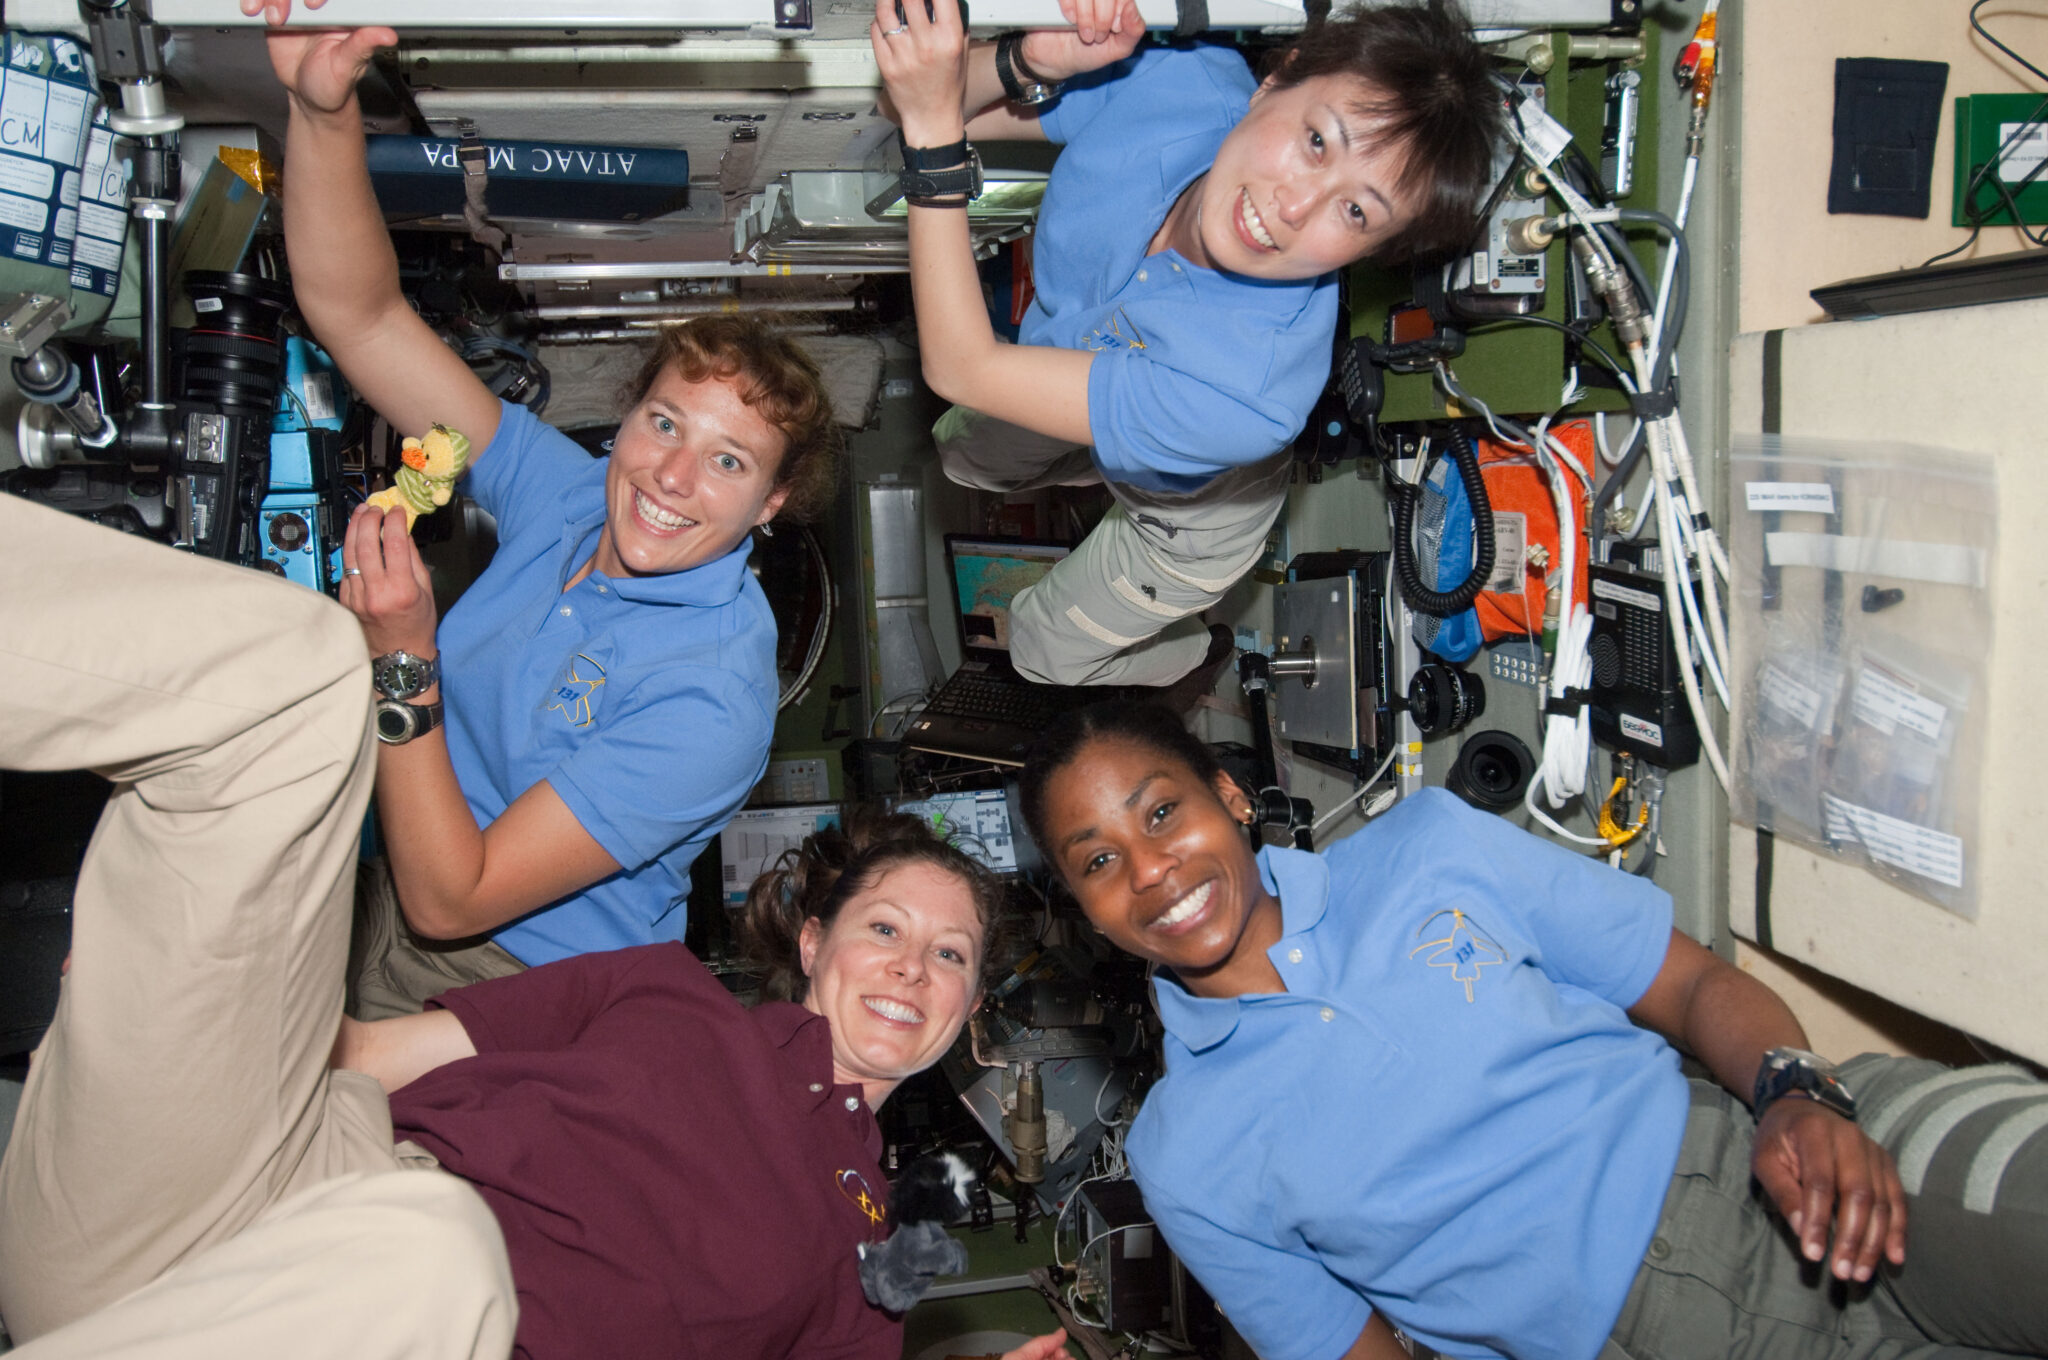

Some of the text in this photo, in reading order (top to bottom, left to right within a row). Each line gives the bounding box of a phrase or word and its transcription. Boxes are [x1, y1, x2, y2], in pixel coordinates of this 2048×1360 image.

[420, 141, 638, 176] АТЛАС МРА
[1099, 334, 1121, 349] 131
[557, 686, 580, 702] 131
[1454, 941, 1476, 964] 131
